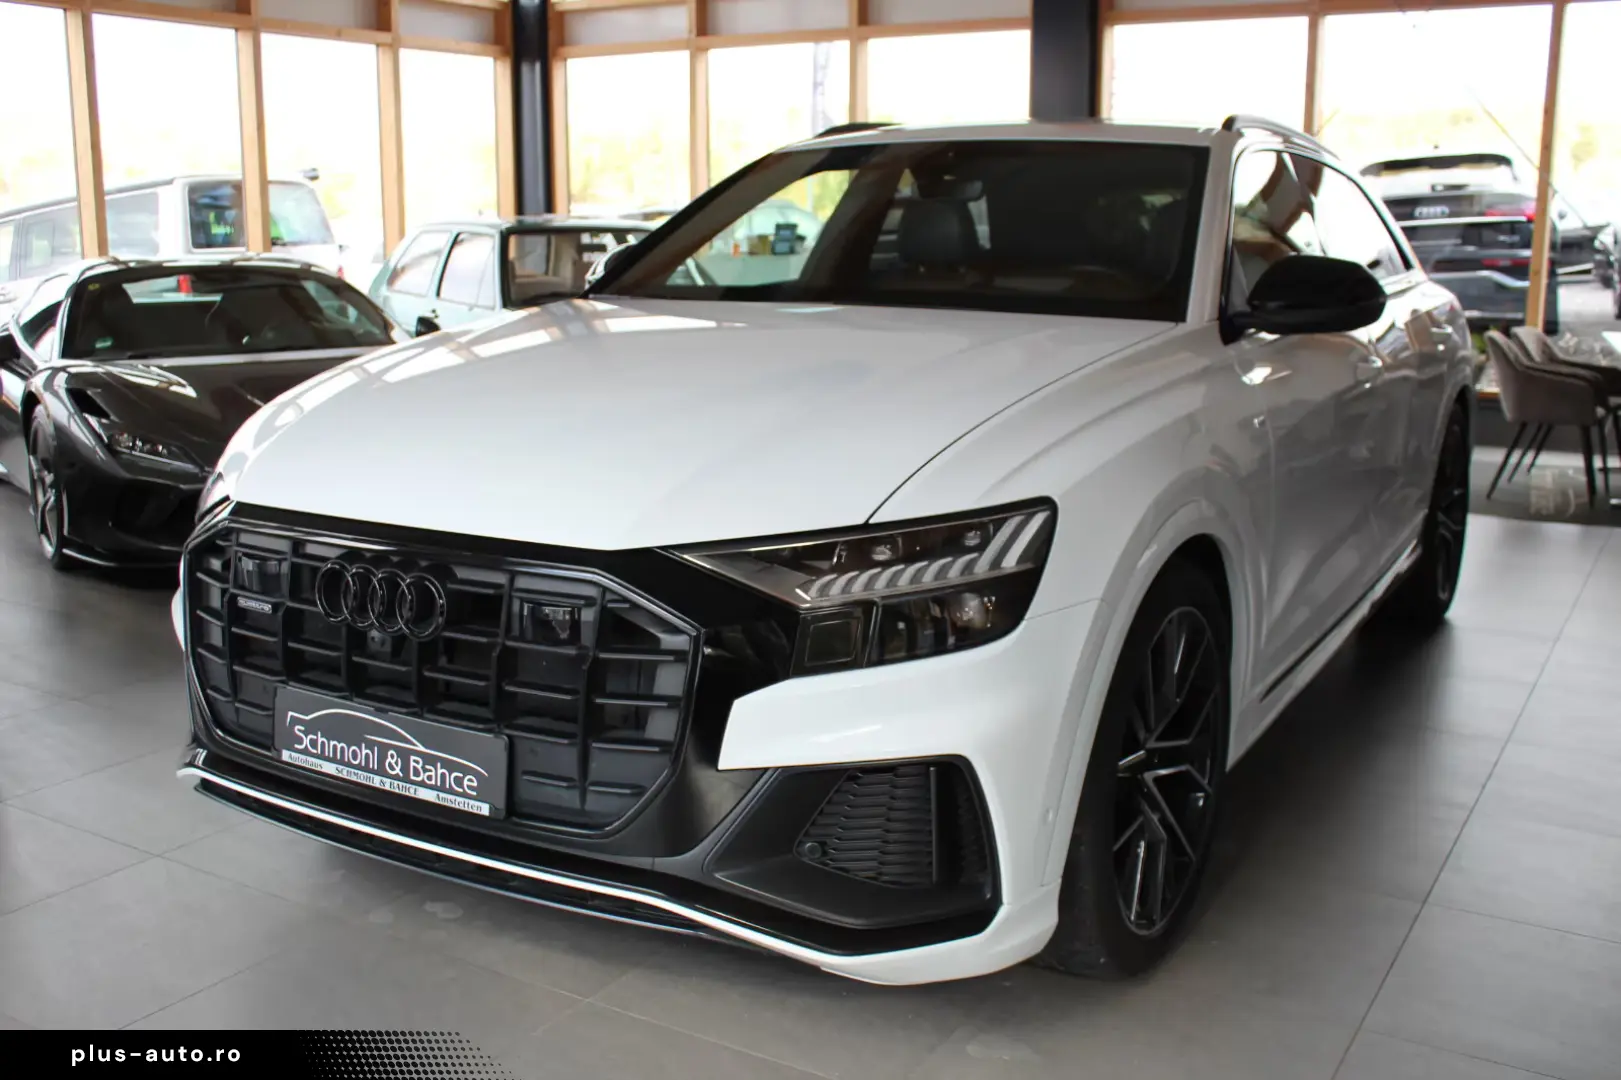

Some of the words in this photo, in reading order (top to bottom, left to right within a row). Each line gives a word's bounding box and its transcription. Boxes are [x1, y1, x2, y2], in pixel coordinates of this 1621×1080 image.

[287, 753, 323, 770] Autohaus
[335, 766, 376, 785] SCHMOHL
[379, 778, 387, 788] &
[389, 782, 419, 796] BAHCE
[434, 793, 482, 813] Amstetten
[294, 725, 378, 770] Schmohl
[385, 749, 403, 777] &
[409, 755, 478, 795] Bahce
